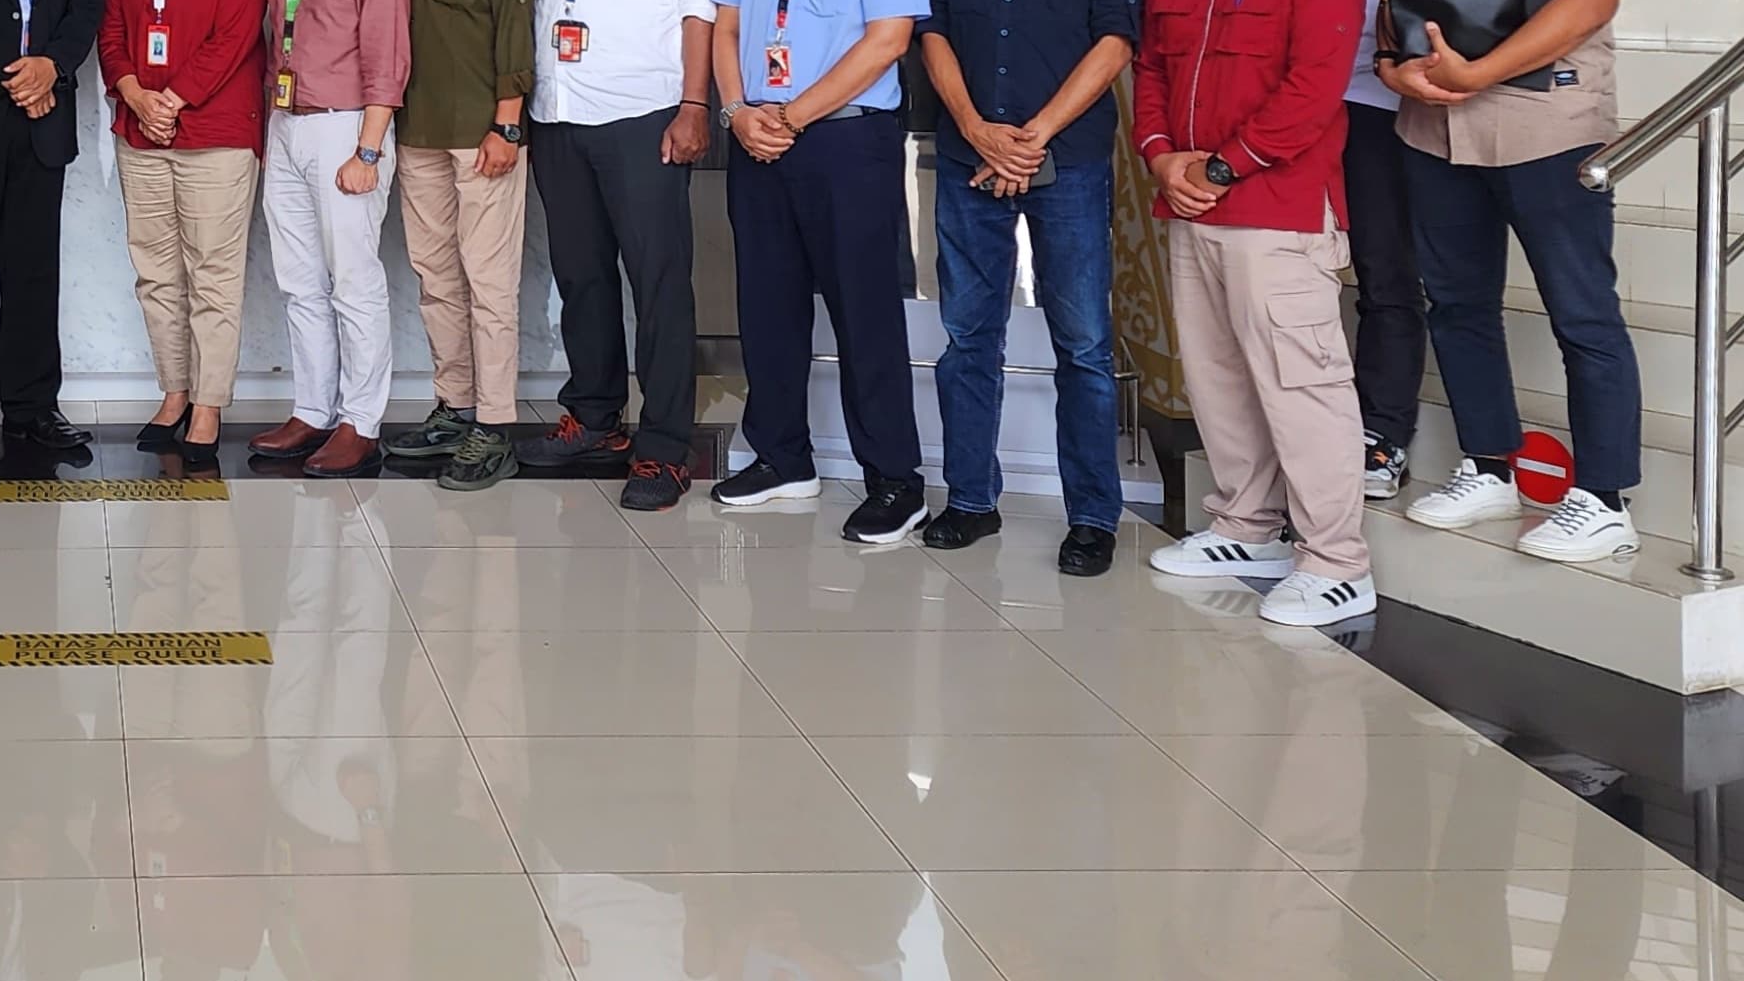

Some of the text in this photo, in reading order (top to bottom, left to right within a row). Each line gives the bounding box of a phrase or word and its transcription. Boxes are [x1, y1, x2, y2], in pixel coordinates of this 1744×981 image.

[15, 638, 222, 649] BATAS ANTRIAN
[15, 649, 223, 661] PLEASE QUEUE
